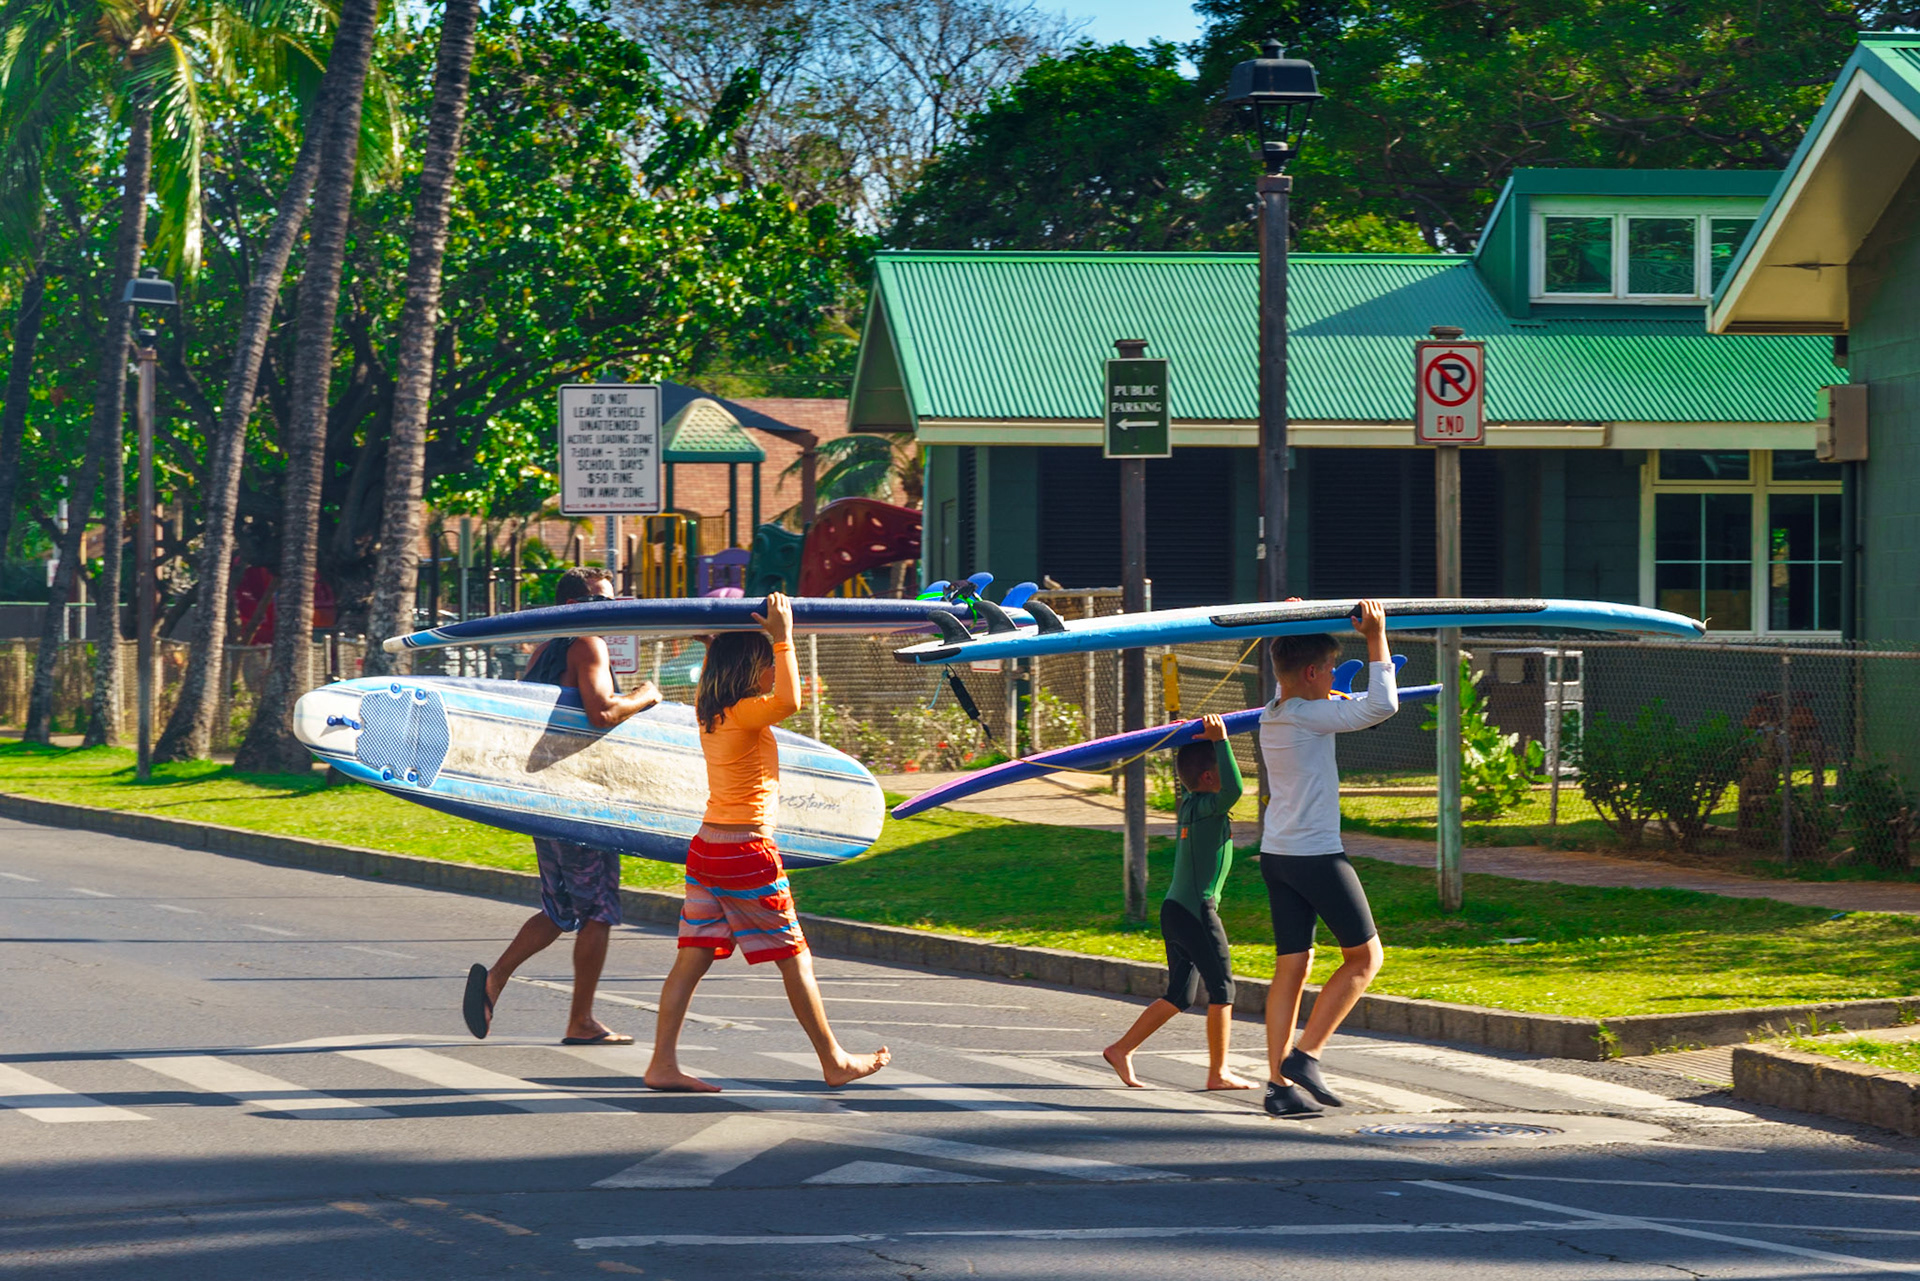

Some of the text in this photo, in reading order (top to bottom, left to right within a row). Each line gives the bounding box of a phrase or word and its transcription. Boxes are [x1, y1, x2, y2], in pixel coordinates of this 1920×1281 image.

[1113, 385, 1159, 396] PUBLIC
[591, 393, 628, 405] DO NOT
[573, 406, 646, 418] LEAVE VEHICLE
[1110, 402, 1162, 413] PARKING
[580, 420, 640, 431] UNATTENDED
[1436, 415, 1464, 433] END
[567, 434, 654, 444] ACTIVE LOADING ZONE
[577, 459, 645, 471] SCHOOL DAYS
[588, 473, 634, 484] $50 FINE
[578, 487, 644, 498] TOW AWAY ZONE
